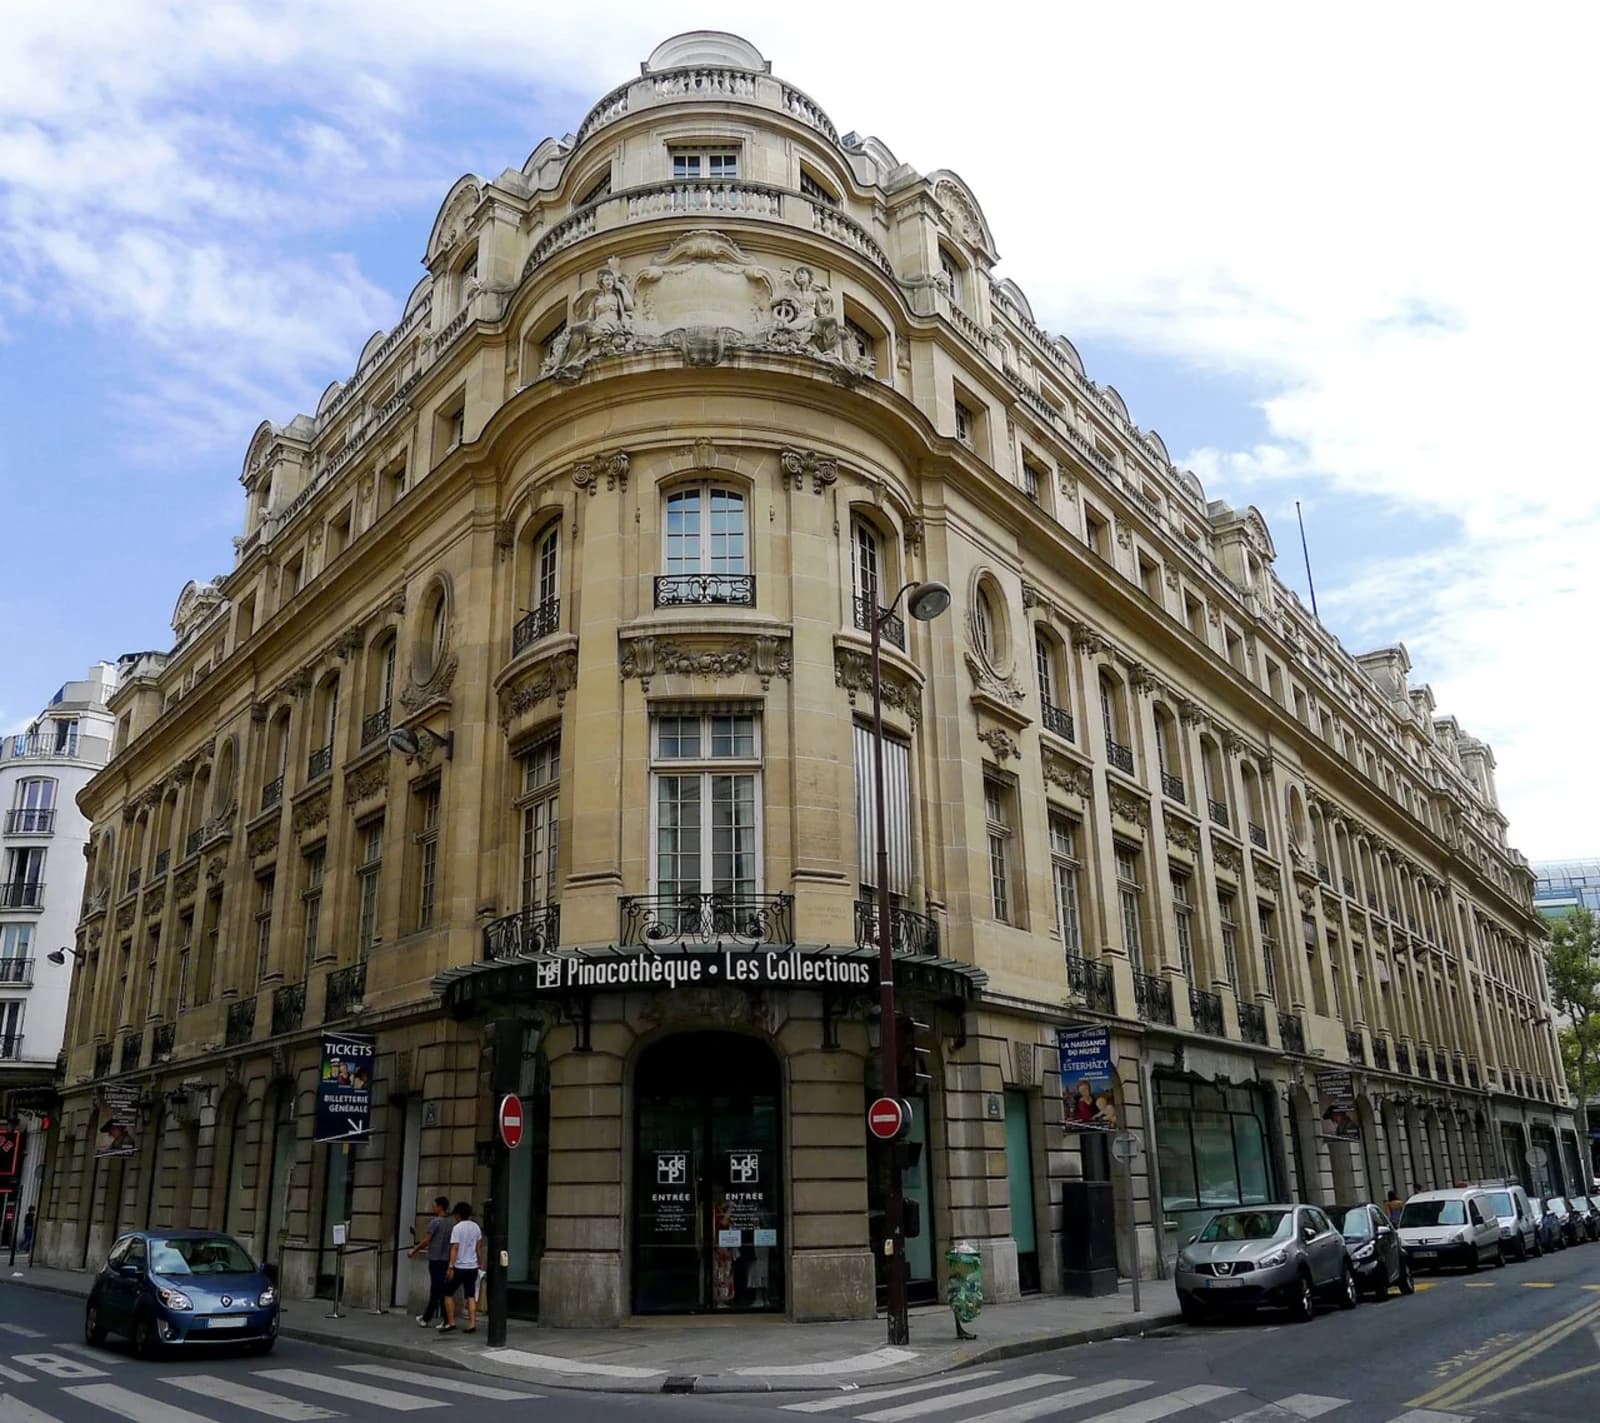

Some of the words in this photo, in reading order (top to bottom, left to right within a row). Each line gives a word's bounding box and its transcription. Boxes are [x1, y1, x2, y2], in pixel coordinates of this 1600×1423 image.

[567, 953, 701, 989] Pinacothèque
[726, 951, 760, 981] Les
[766, 952, 870, 984] Collections
[1070, 1039, 1107, 1048] NAISSANCE
[324, 1043, 373, 1057] TICKETS
[323, 1094, 369, 1104] BILLETTERIE
[328, 1103, 369, 1114] GÉNÉRALE
